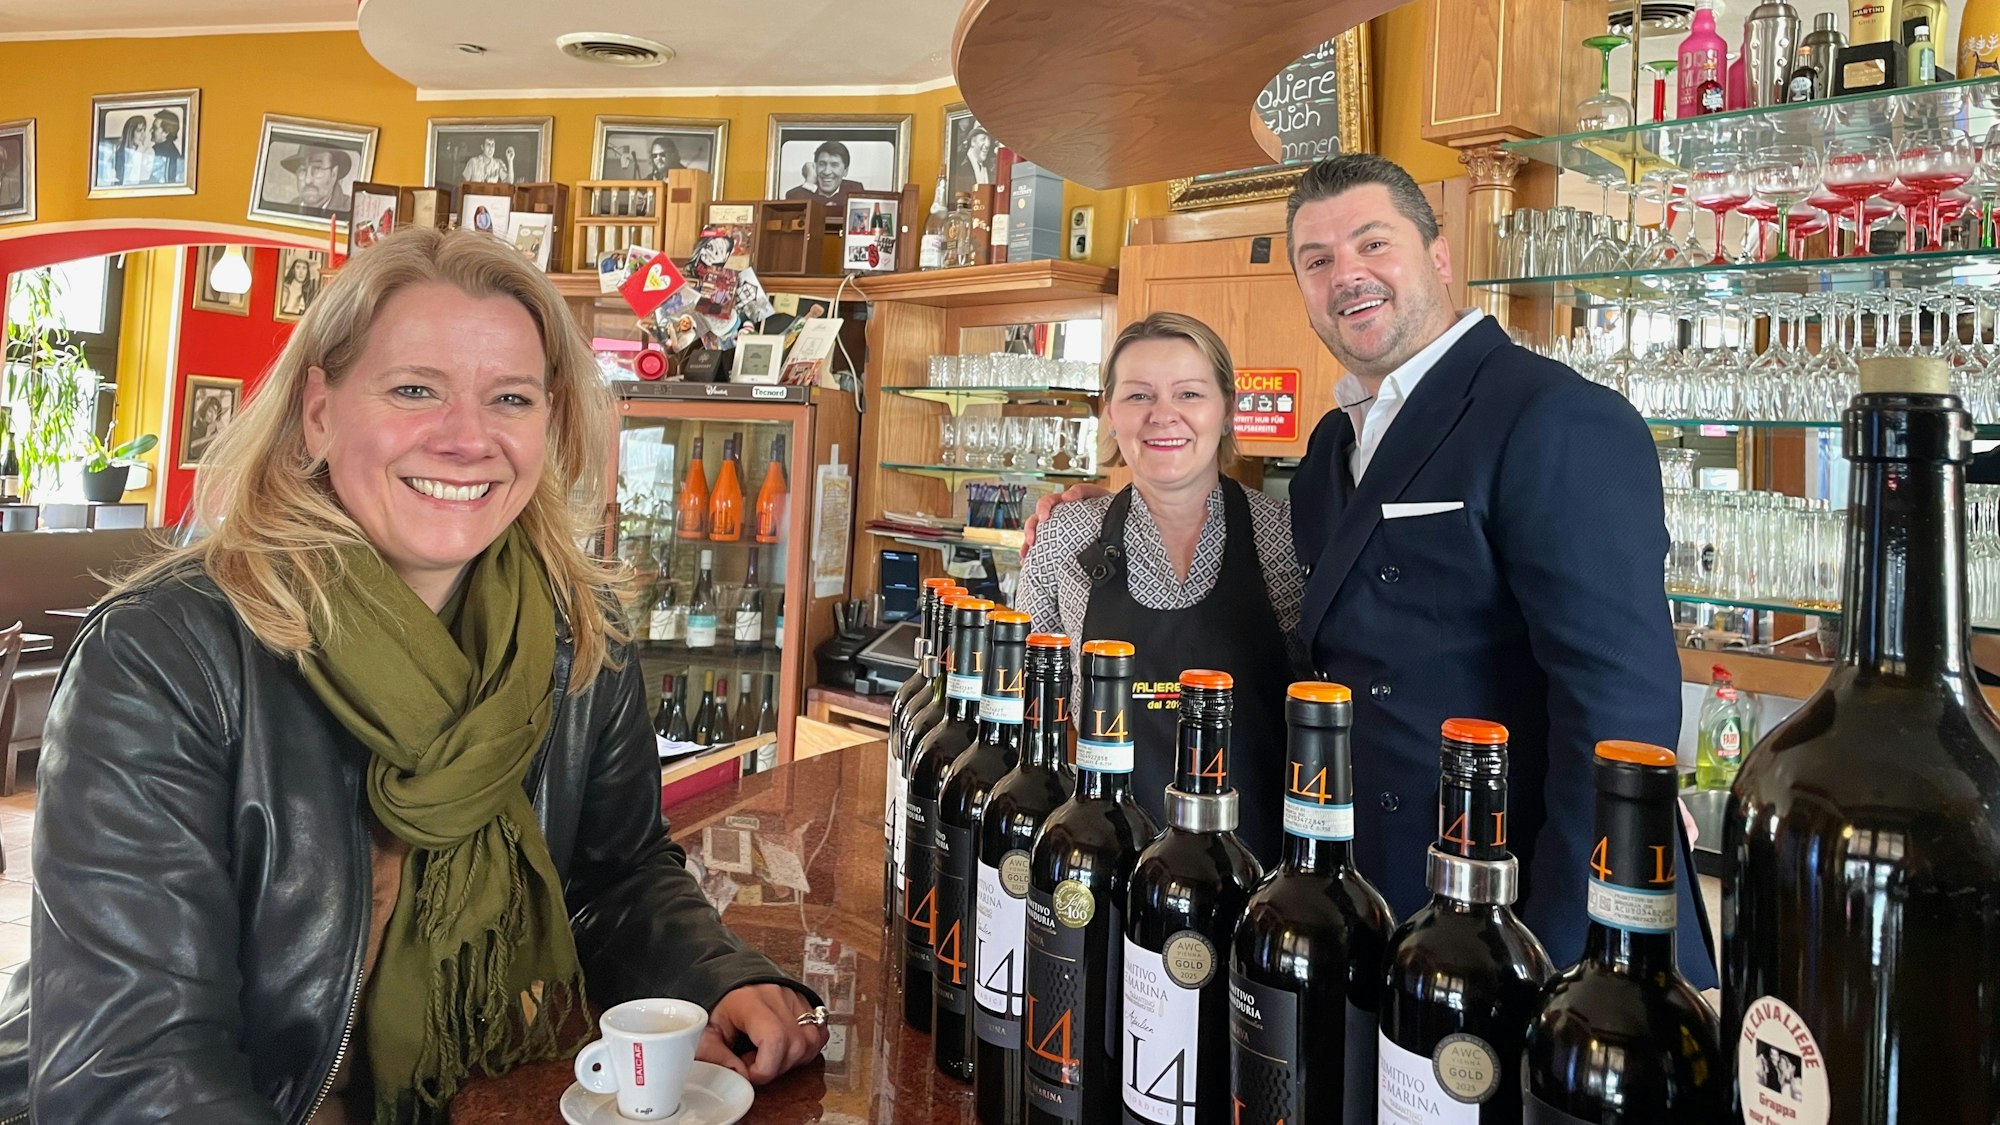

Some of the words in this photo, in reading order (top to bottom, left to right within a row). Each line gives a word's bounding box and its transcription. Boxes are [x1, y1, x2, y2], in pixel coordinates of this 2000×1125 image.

[1853, 6, 1884, 17] MARTINI
[754, 388, 785, 397] Tecnord
[1271, 415, 1285, 424] FÜR
[1147, 700, 1162, 709] dal
[1092, 709, 1128, 744] 14
[1187, 746, 1227, 787] 14
[1289, 760, 1333, 805] 14
[1008, 874, 1029, 883] GOLD
[1068, 906, 1089, 921] 100
[1177, 942, 1202, 952] AWC
[1175, 960, 1203, 969] GOLD
[1180, 971, 1198, 980] 2025
[1026, 994, 1081, 1084] 14
[1743, 1026, 1757, 1045] IL
[1751, 1003, 1820, 1070] CAVALIERE
[1451, 1047, 1481, 1060] AWC
[634, 1043, 645, 1086] SAICAF
[1126, 1029, 1197, 1125] 14
[1449, 1068, 1484, 1081] GOLD
[1456, 1081, 1477, 1092] 2025
[1758, 1092, 1797, 1119] Grappa
